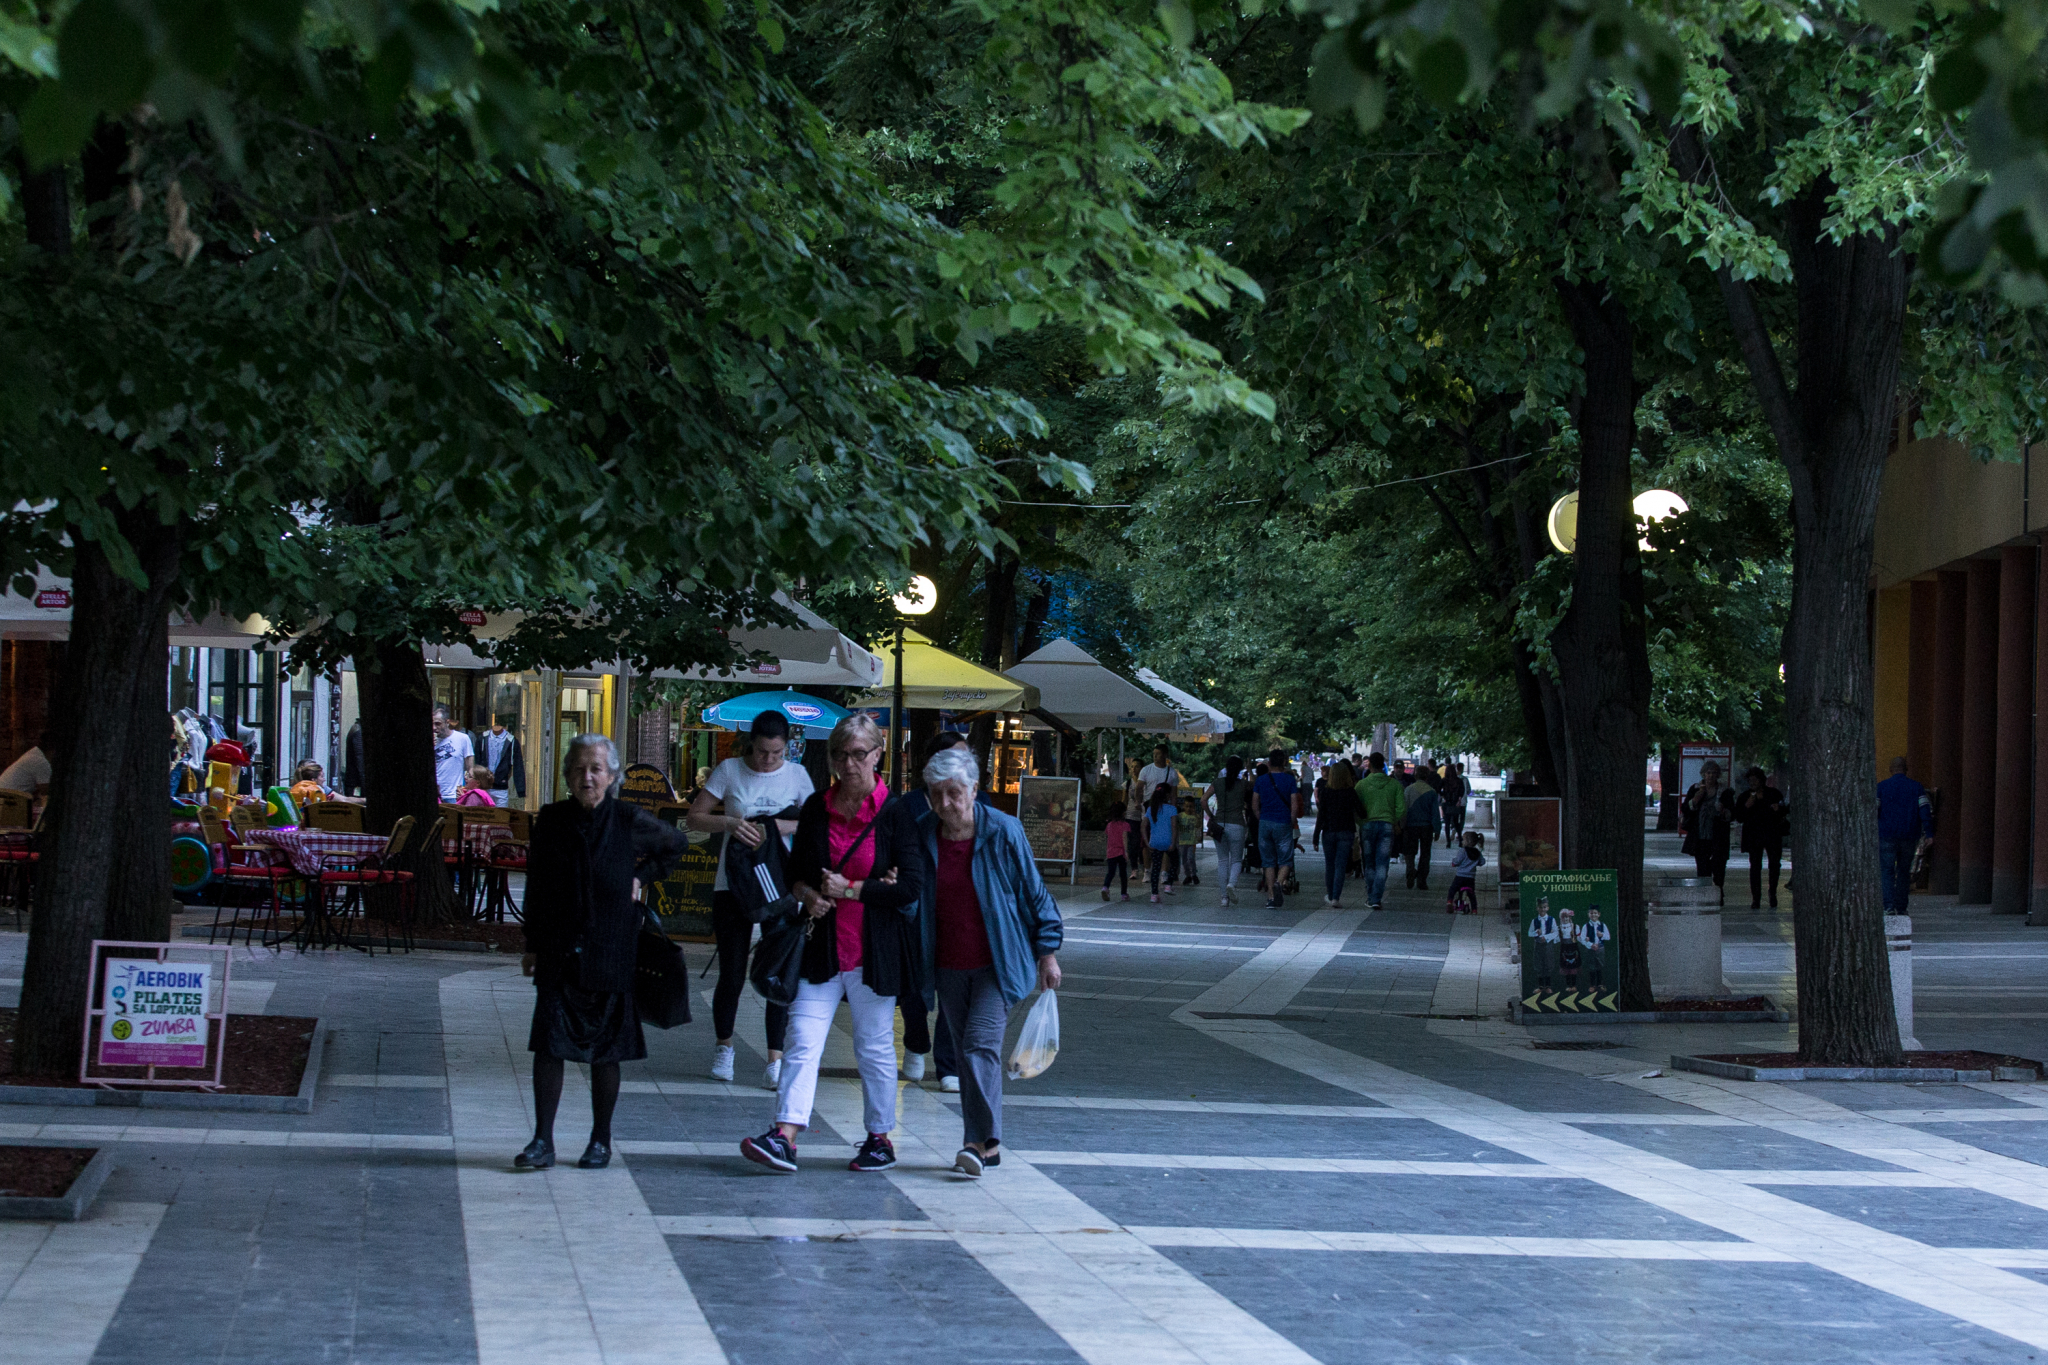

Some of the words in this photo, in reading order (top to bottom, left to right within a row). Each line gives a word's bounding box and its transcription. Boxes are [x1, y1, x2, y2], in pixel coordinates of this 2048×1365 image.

[1522, 874, 1612, 883] ФОТОГРАФИСАЊЕ
[1542, 884, 1549, 892] У
[1550, 884, 1592, 892] НОШЊИ
[136, 971, 203, 988] AEROBIK
[134, 991, 202, 1005] PILATES
[133, 1004, 146, 1014] SA
[150, 1005, 201, 1015] LOPTAMA
[140, 1019, 196, 1036] ZUMBA
